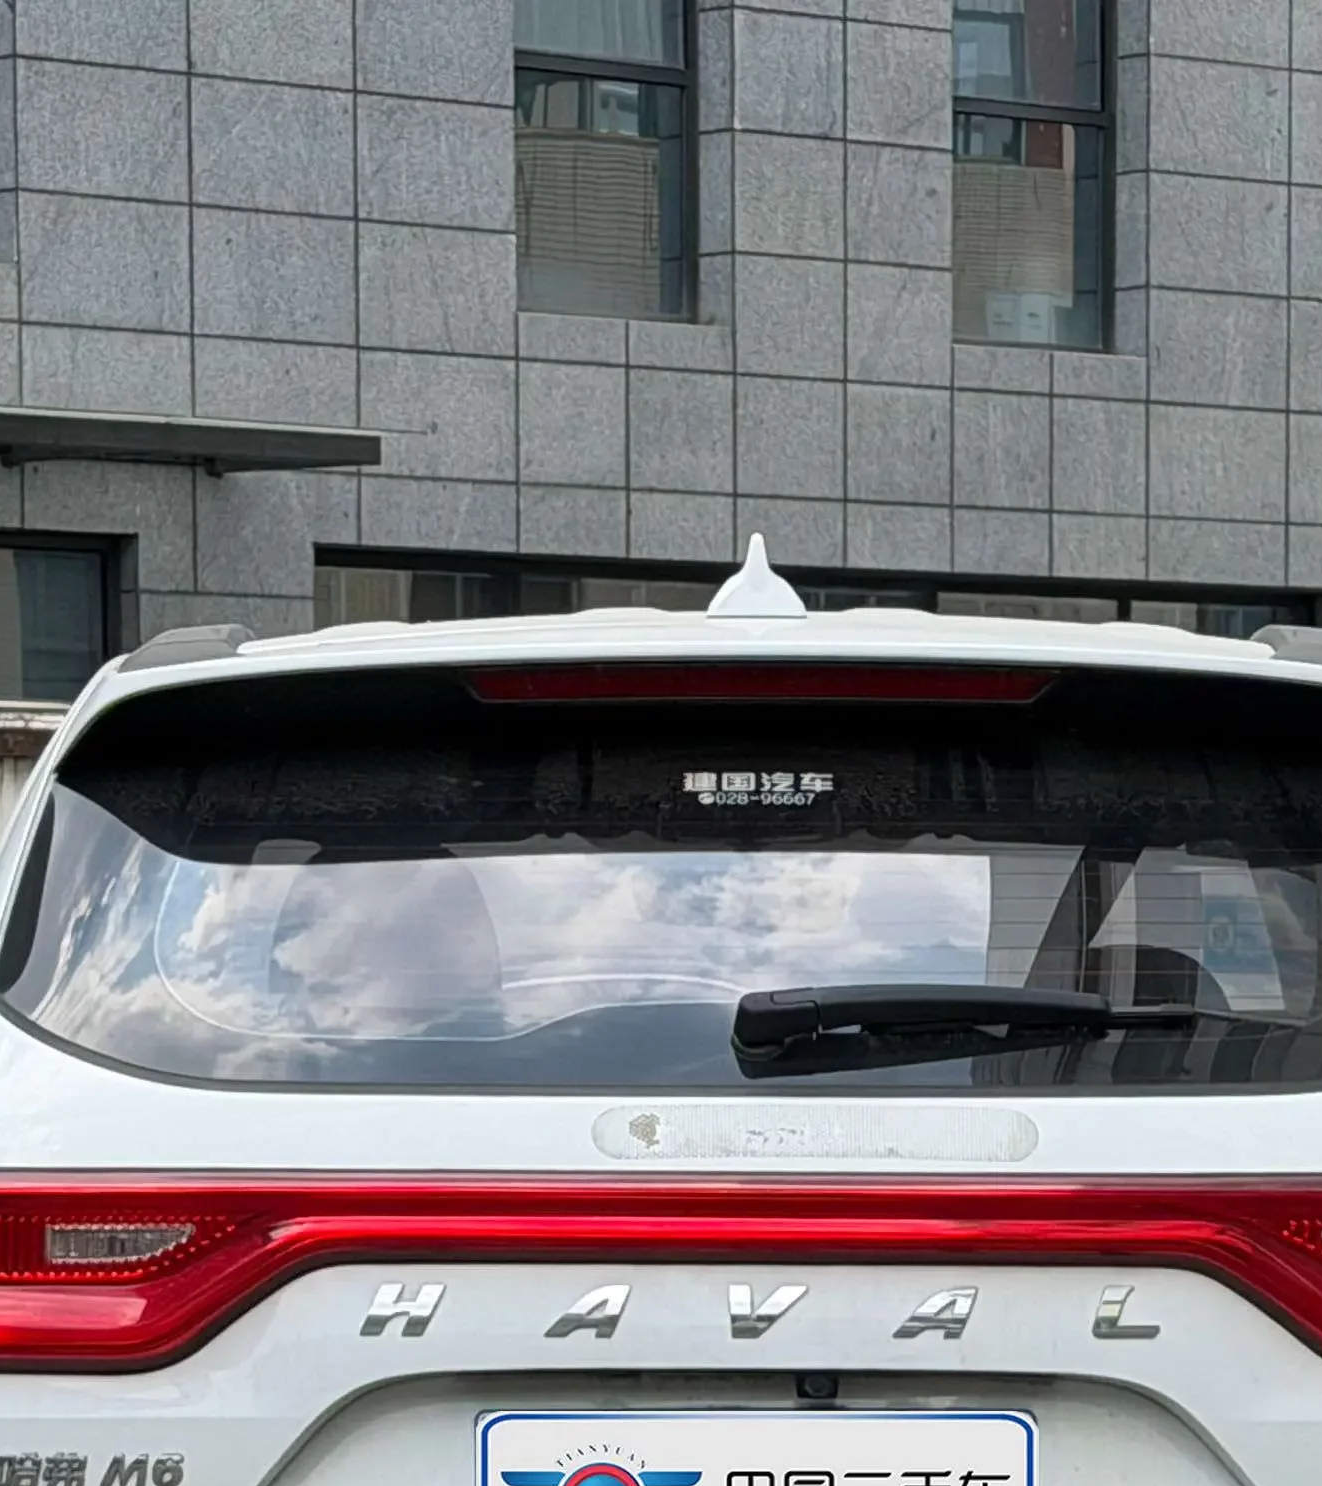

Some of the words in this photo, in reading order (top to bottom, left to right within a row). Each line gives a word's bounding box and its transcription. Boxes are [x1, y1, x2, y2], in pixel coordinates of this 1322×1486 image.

[683, 772, 834, 792] 建国汽车
[715, 792, 815, 806] 028-96667
[359, 1283, 1161, 1339] HAVAL
